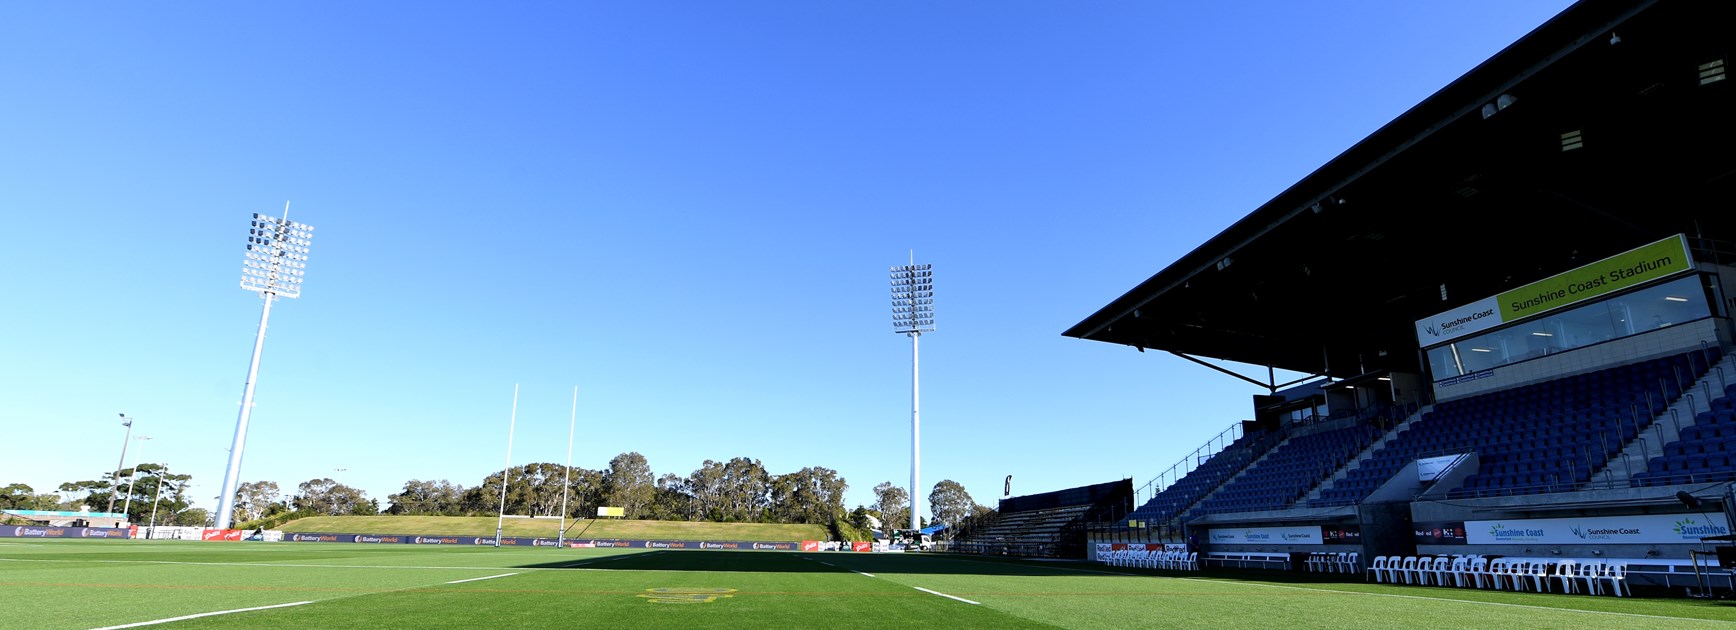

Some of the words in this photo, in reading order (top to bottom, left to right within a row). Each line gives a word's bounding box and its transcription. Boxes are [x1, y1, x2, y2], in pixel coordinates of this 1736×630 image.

[1511, 288, 1566, 312] Sunshine
[1568, 275, 1606, 294] Coast
[1609, 256, 1672, 282] Stadium
[1441, 316, 1472, 330] Sunshine
[1472, 309, 1494, 320] Coast
[1442, 325, 1465, 335] COUNCIL
[1495, 529, 1525, 537] Sunshine
[1525, 528, 1544, 537] Coast
[1587, 528, 1619, 536] Sunshine
[1680, 525, 1727, 535] Sunshine
